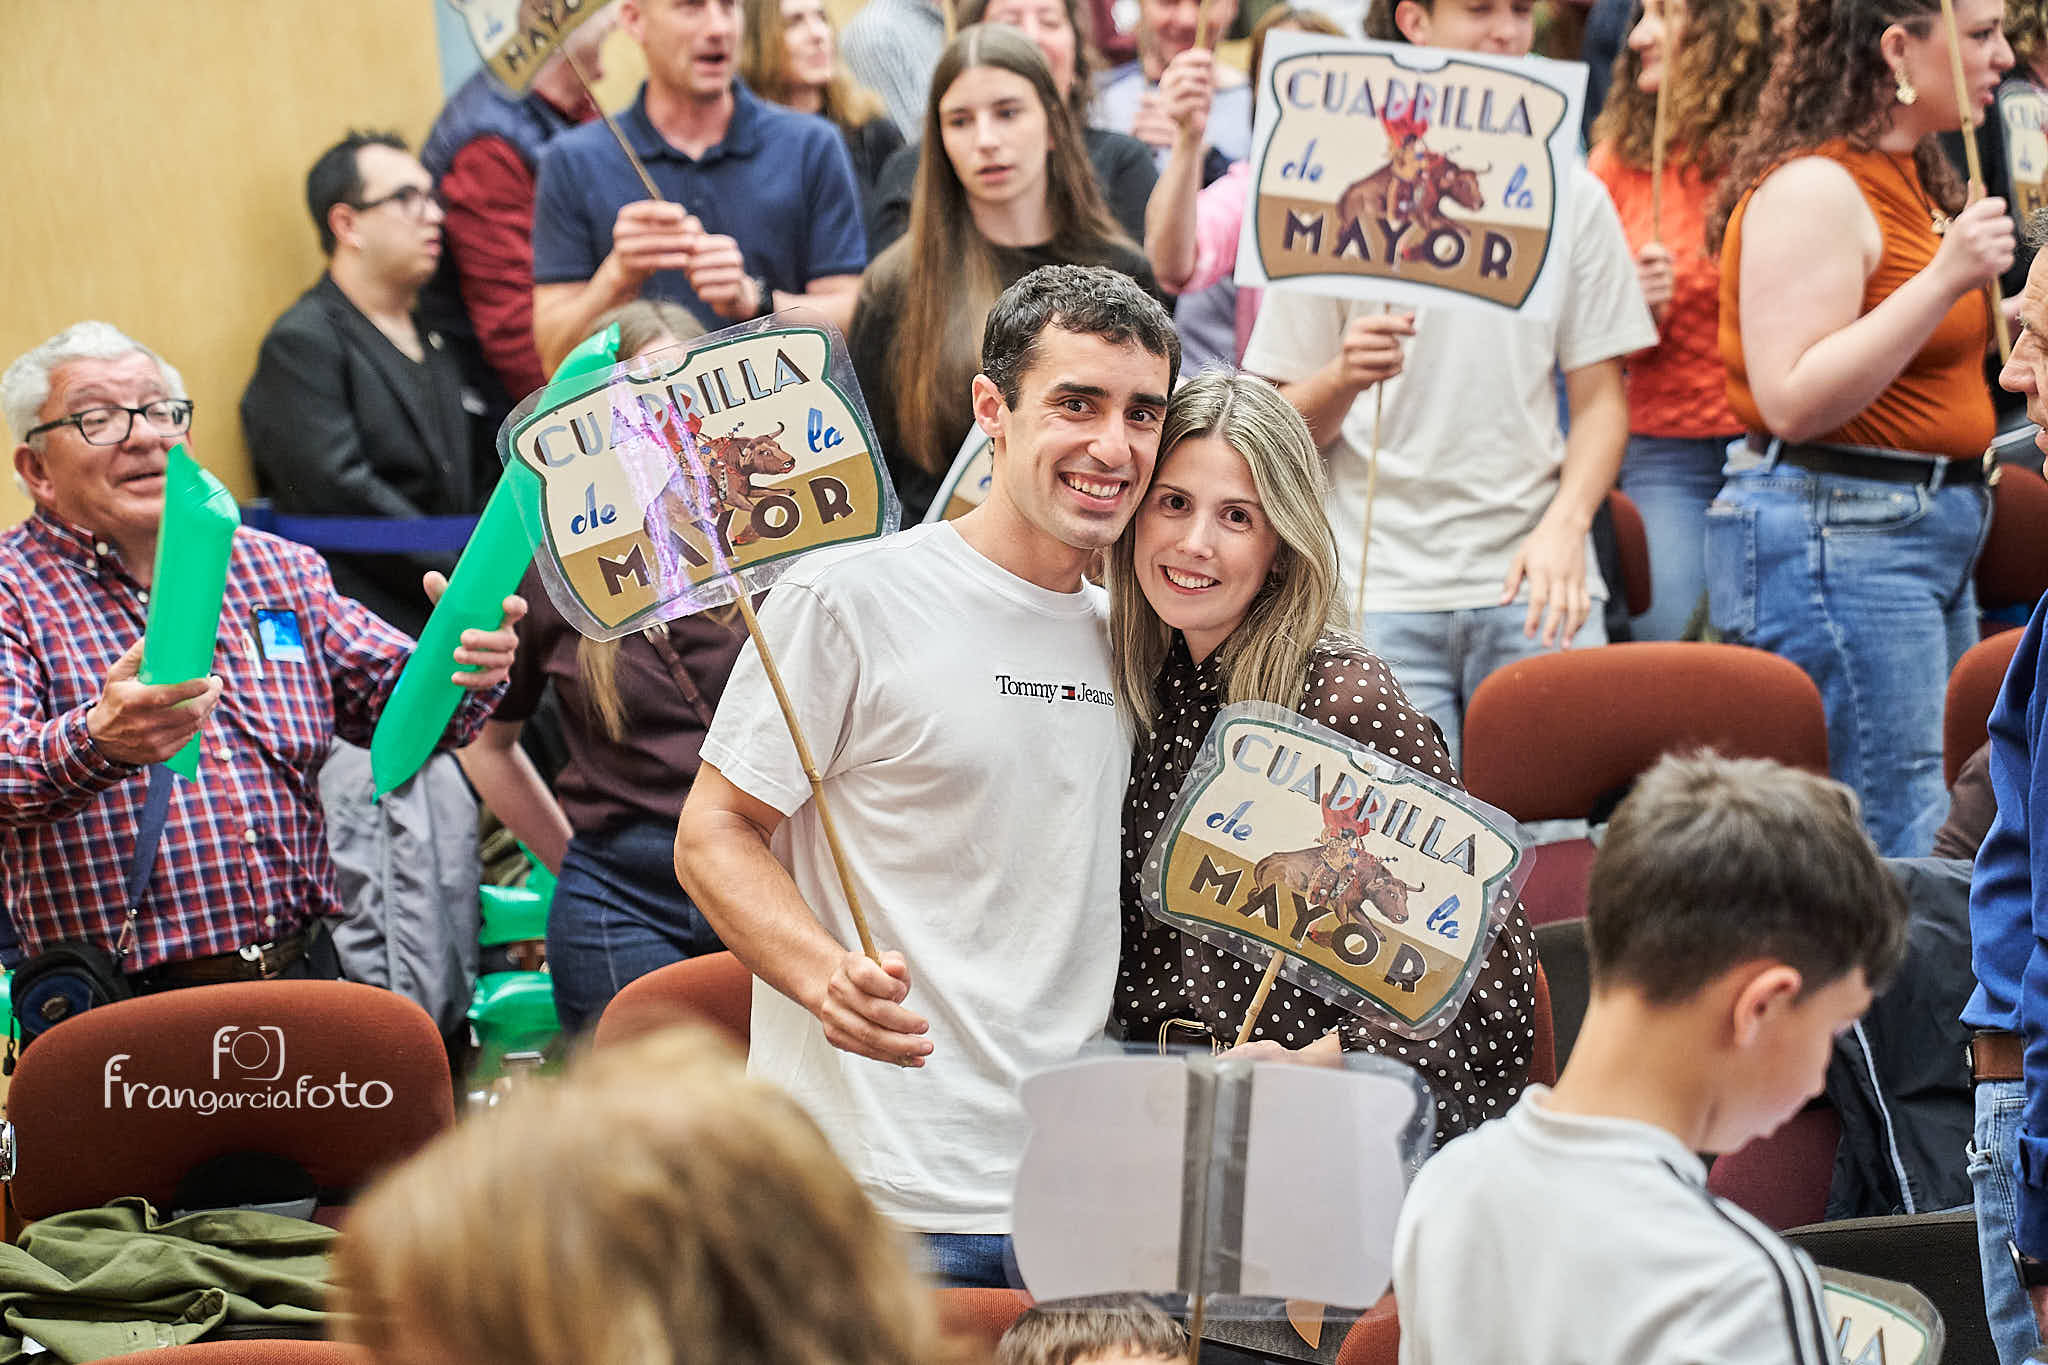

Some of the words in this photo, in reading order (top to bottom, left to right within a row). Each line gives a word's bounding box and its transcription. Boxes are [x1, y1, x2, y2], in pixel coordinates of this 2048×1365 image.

[1287, 68, 1533, 137] CUADRILLA
[1281, 138, 1325, 182] de
[1503, 163, 1534, 210] la
[1283, 207, 1514, 280] MAYOR
[807, 407, 845, 453] la
[570, 481, 617, 535] de
[995, 675, 1059, 704] Tommy
[1077, 682, 1115, 707] Jeans
[1206, 800, 1256, 842] de
[1232, 734, 1478, 877] CUADRILLA
[1189, 854, 1428, 994] MAYOR
[1426, 894, 1462, 940] la
